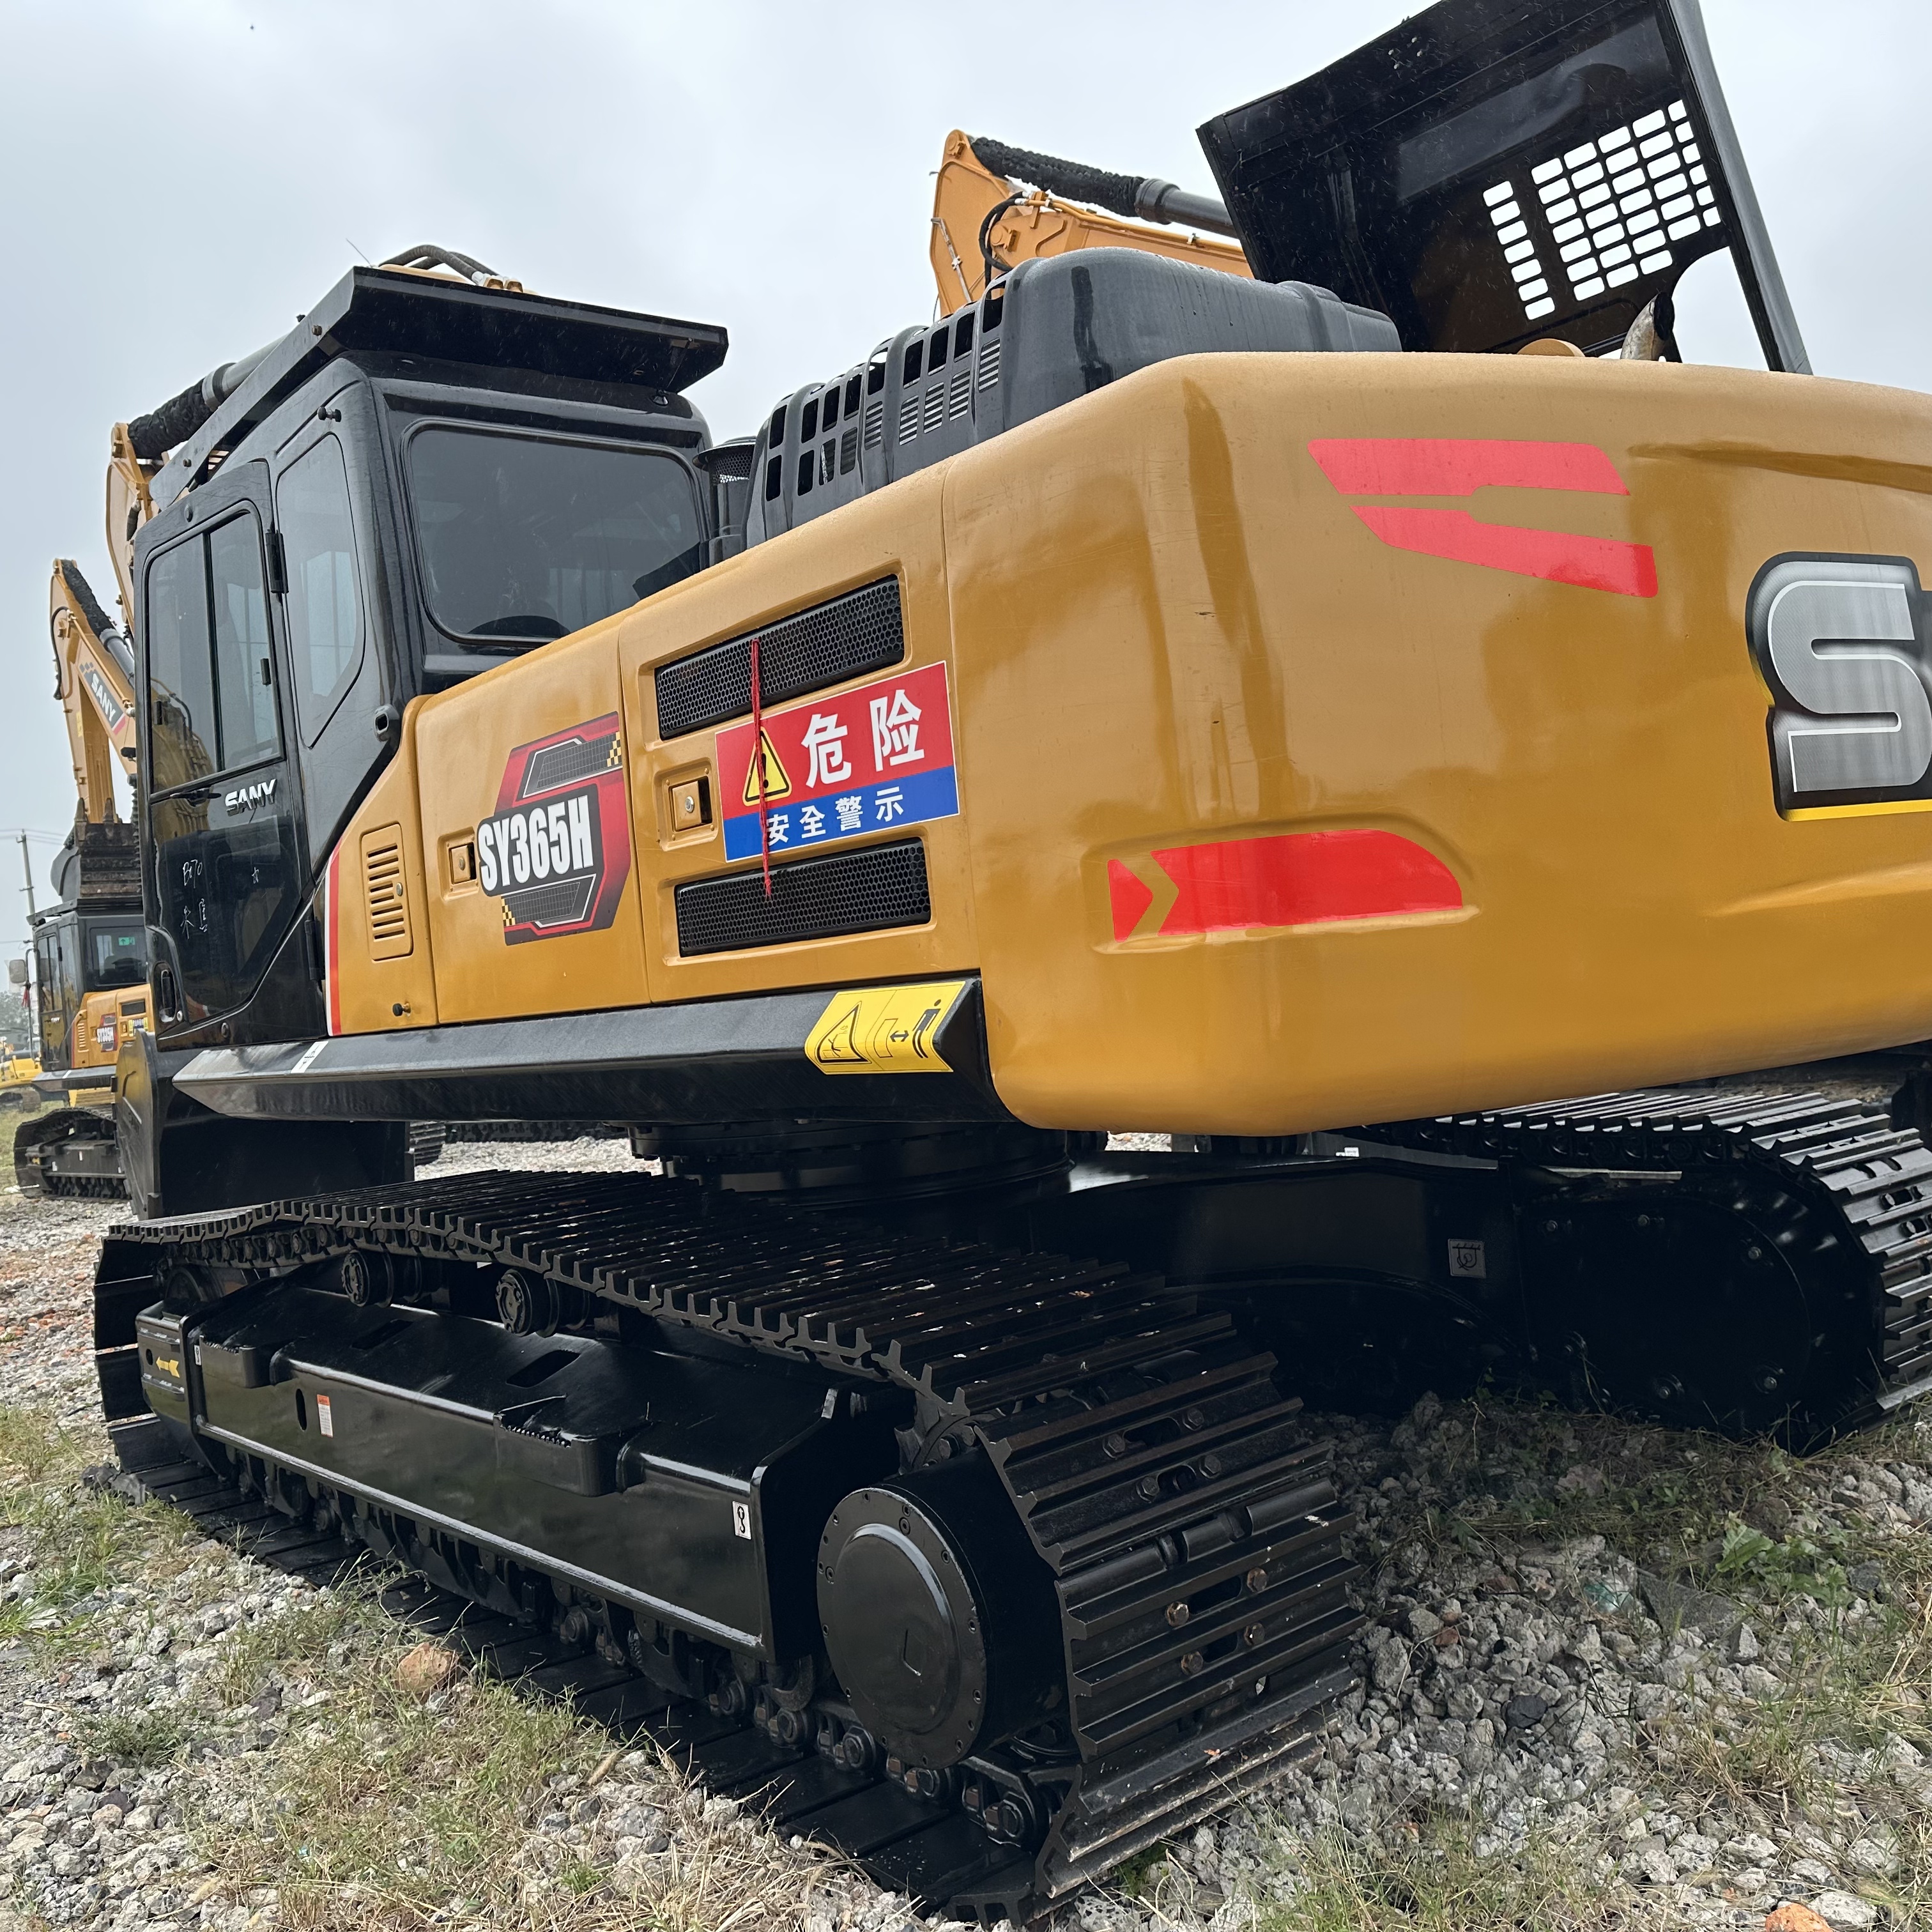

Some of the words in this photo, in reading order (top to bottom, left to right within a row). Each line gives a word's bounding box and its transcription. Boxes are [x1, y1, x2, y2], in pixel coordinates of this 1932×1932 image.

[91, 673, 116, 723] SANY
[801, 689, 925, 789] 危险
[225, 778, 277, 817] SANY
[766, 786, 905, 847] 安全警示
[478, 795, 594, 891] SY365H
